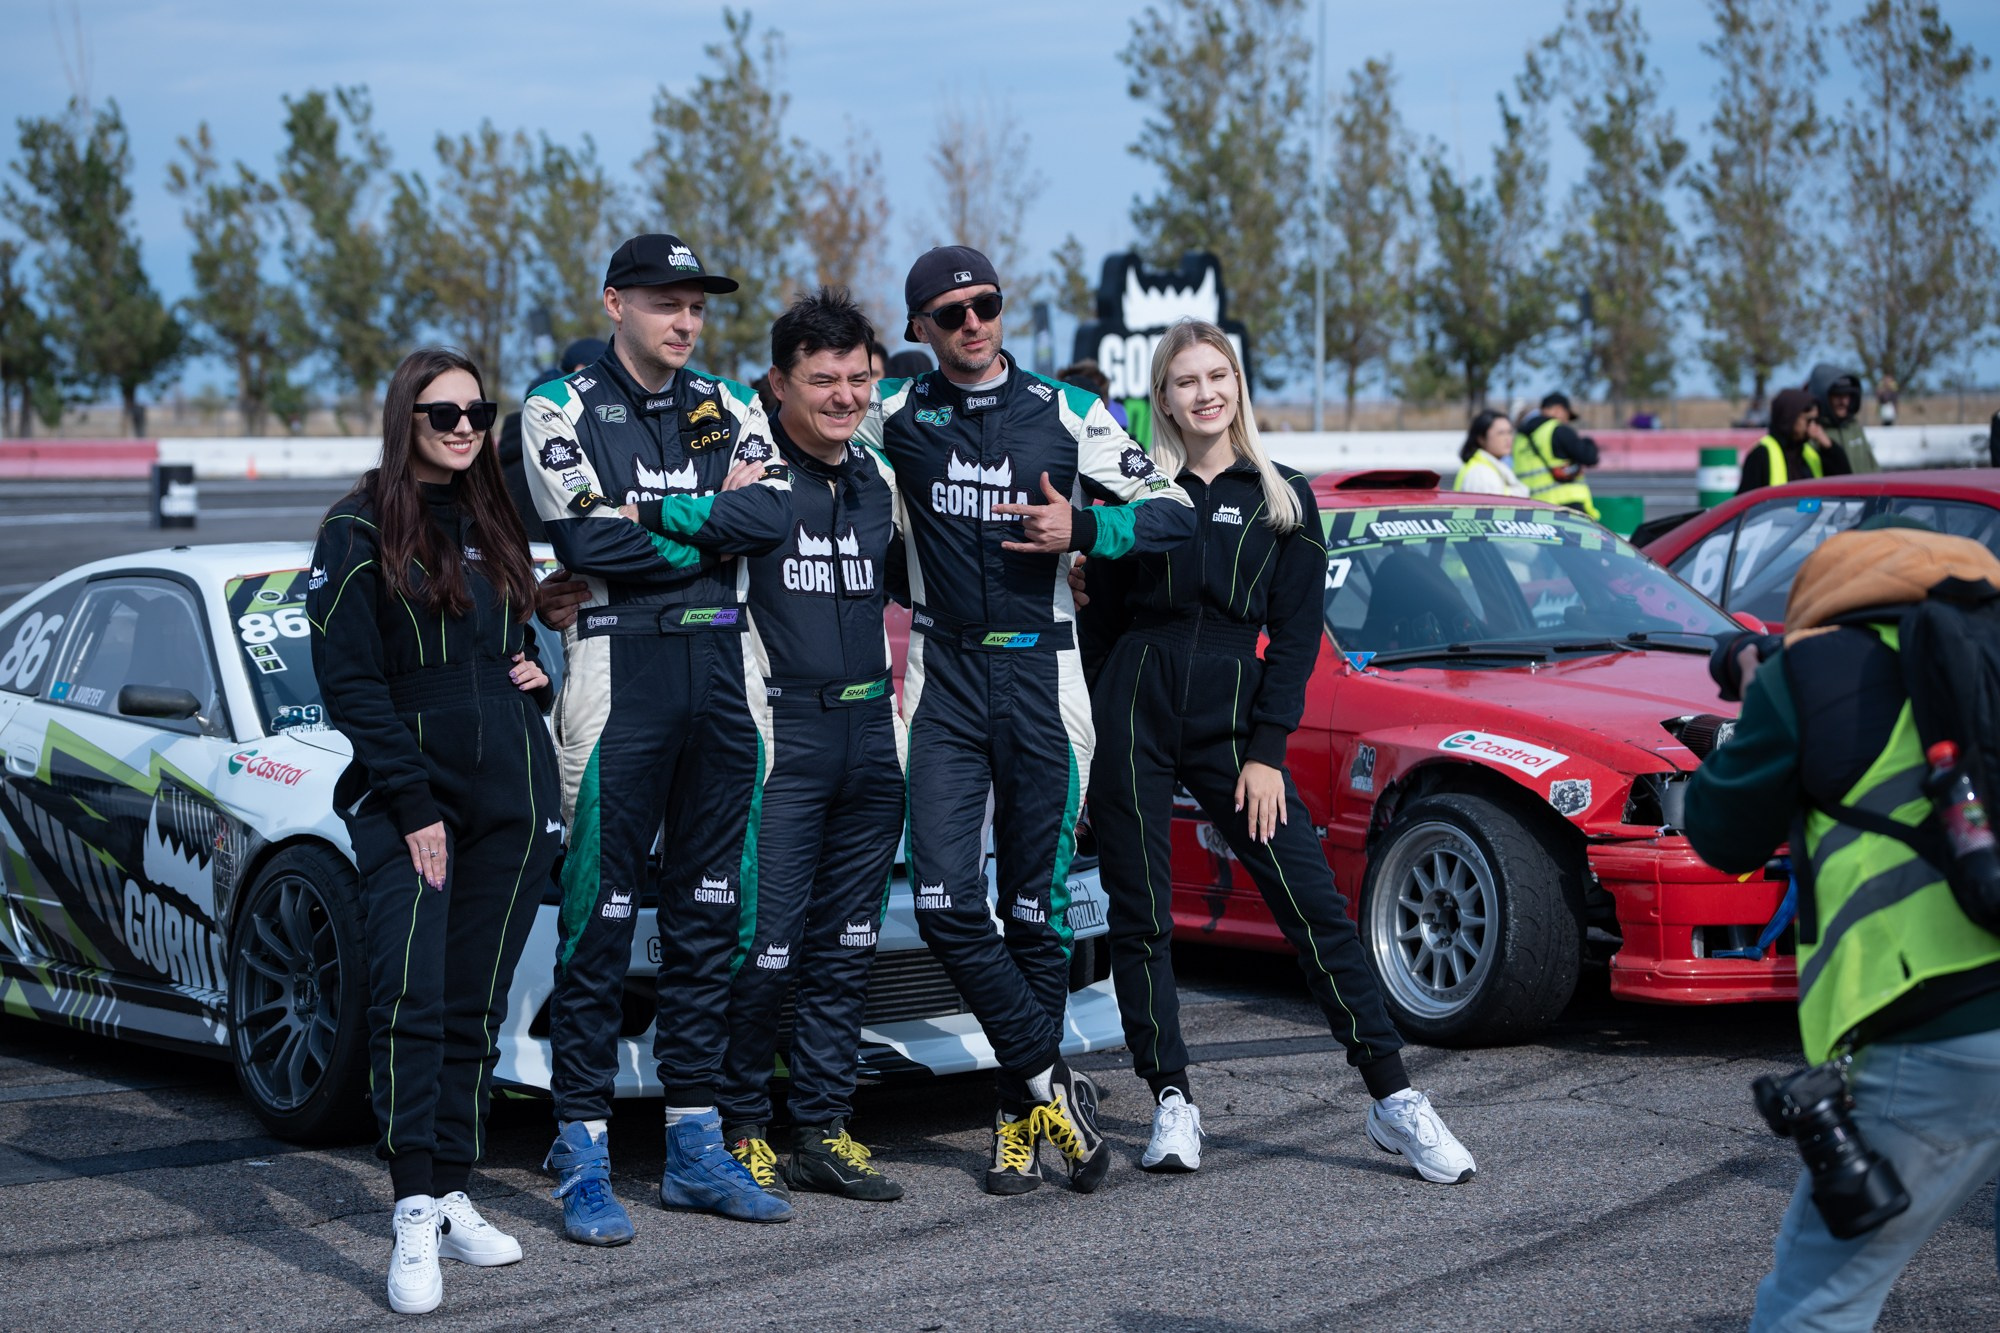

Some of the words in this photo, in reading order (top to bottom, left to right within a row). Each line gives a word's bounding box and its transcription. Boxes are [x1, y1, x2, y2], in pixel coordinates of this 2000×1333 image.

[668, 254, 699, 268] GORILLA
[1028, 384, 1053, 403] GORILLA
[966, 396, 997, 409] freem
[595, 405, 626, 423] 12
[690, 429, 730, 449] CADS
[1086, 425, 1111, 438] freem
[551, 452, 571, 464] CREW
[744, 448, 764, 458] CREW
[564, 476, 589, 489] GORILLA
[931, 482, 1029, 521] GORILLA
[1213, 512, 1243, 525] GORILLA
[1369, 519, 1450, 538] GORILLA
[1494, 520, 1558, 537] CHAMP
[783, 558, 874, 593] GORILLA
[238, 608, 310, 643] 86
[586, 616, 618, 629] freem
[0, 612, 64, 690] 86
[1470, 739, 1552, 768] Castrol
[247, 756, 311, 786] Castrol
[694, 888, 735, 904] GORILLA
[916, 895, 952, 909] GORILLA
[602, 903, 632, 919] GORILLA
[1012, 904, 1045, 923] GORILLA
[1067, 900, 1104, 930] ORILLA
[840, 933, 877, 947] GORILLA
[756, 953, 789, 970] GORILLA
